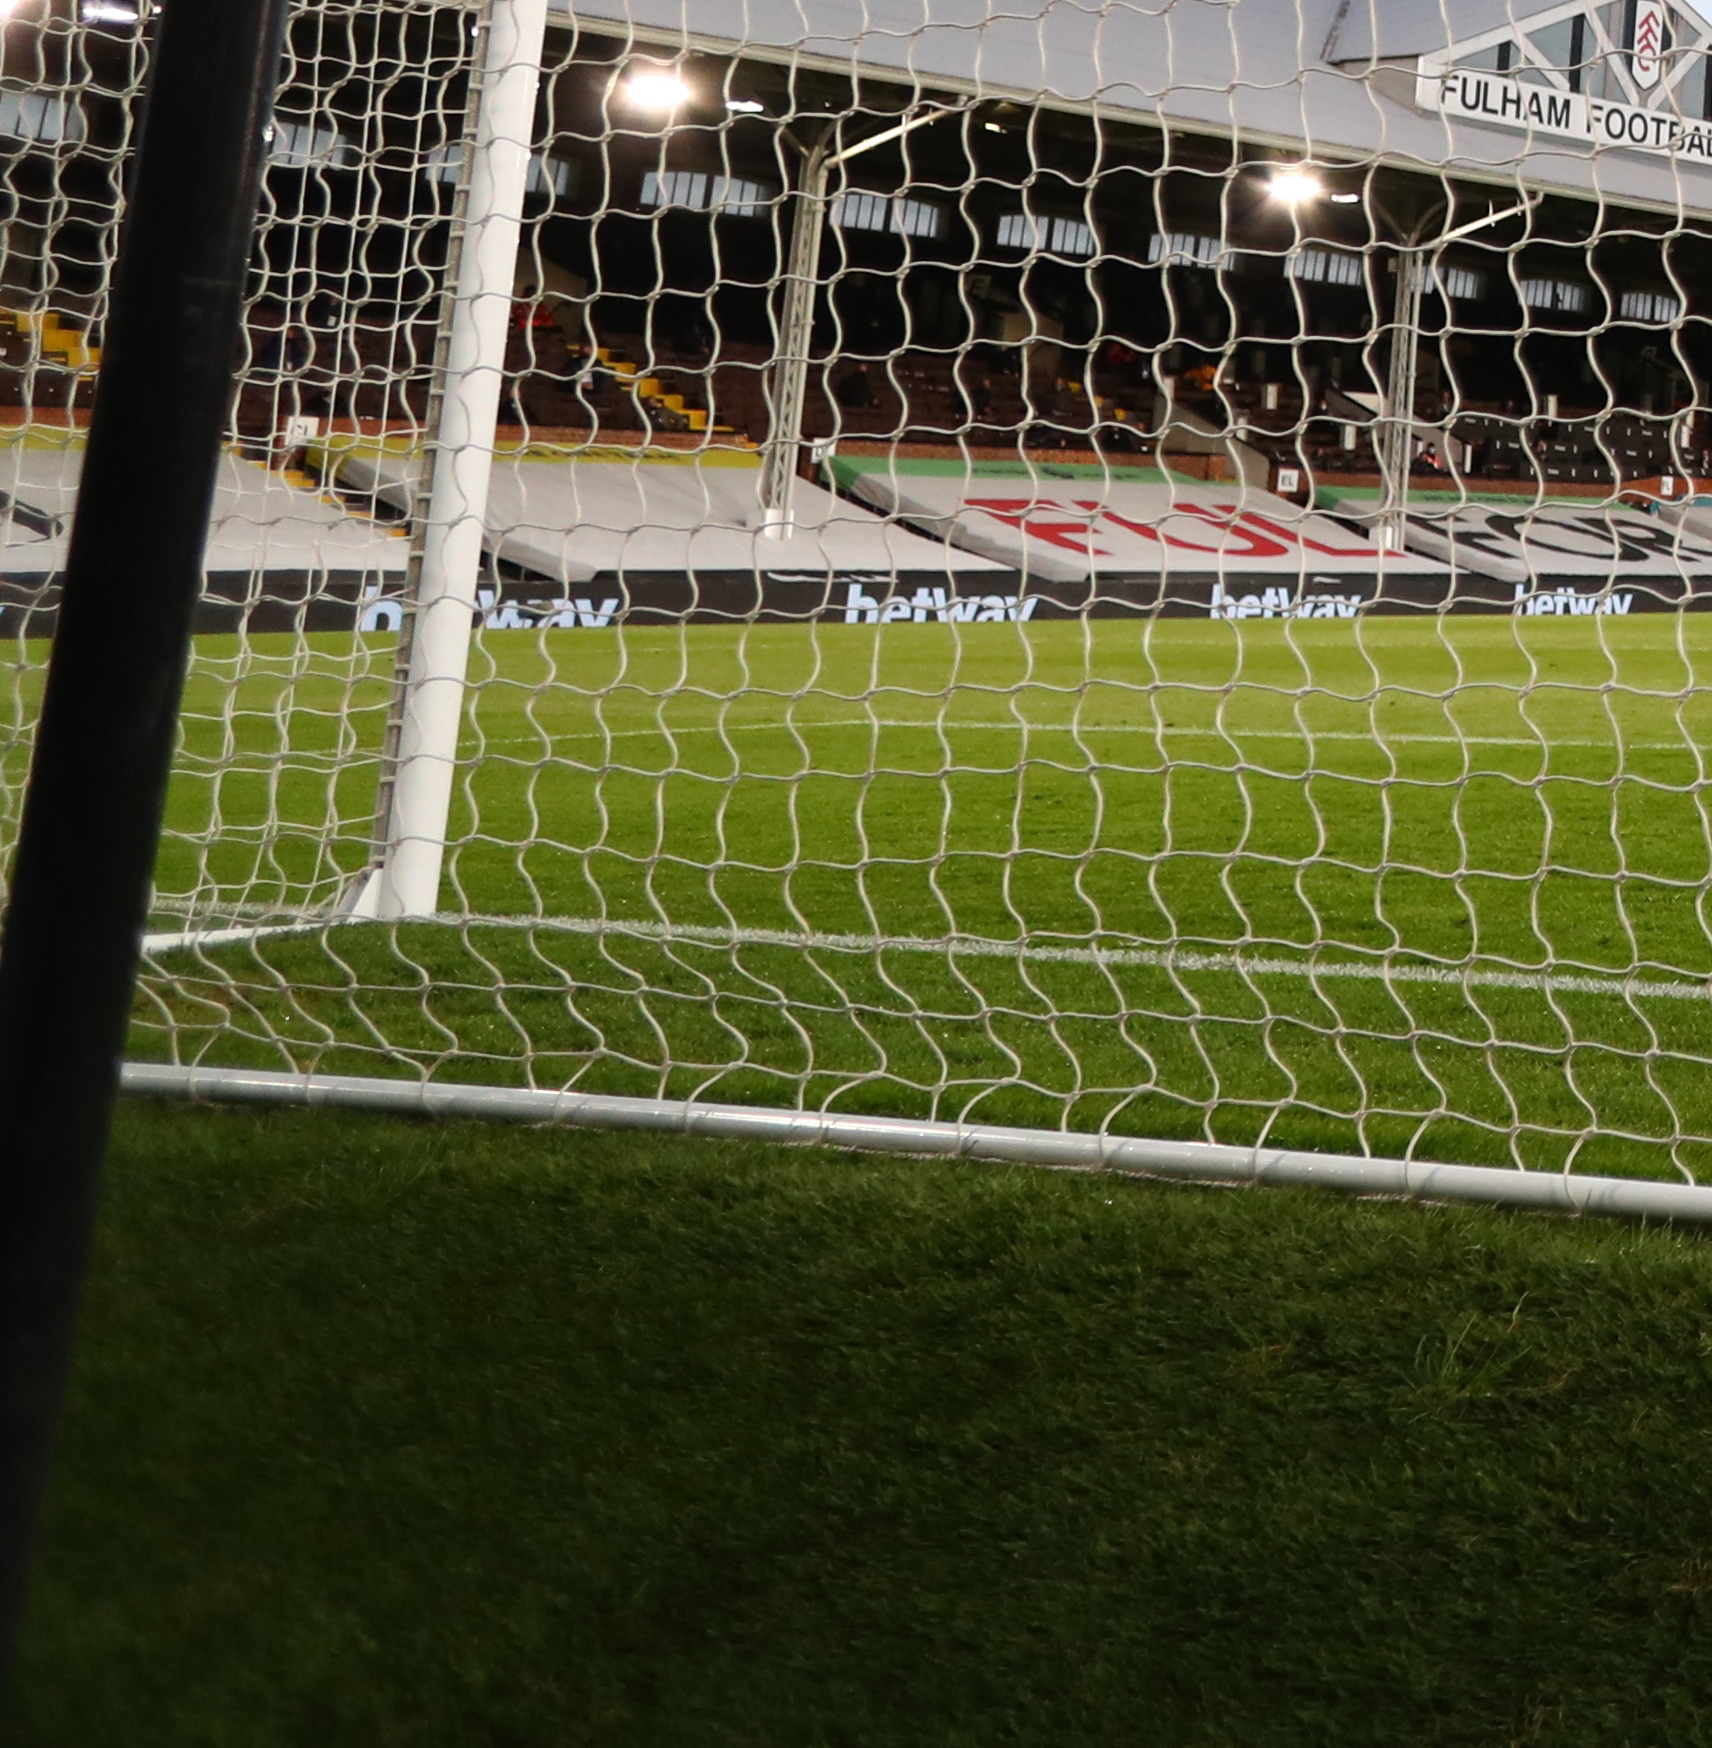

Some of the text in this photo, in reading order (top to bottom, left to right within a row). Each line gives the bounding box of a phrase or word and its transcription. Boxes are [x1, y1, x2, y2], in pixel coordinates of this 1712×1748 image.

[1441, 75, 1572, 129] FULHAM
[359, 585, 617, 632] bway
[845, 583, 1036, 624] betway
[1210, 583, 1362, 619] betway
[1513, 583, 1633, 616] betway
